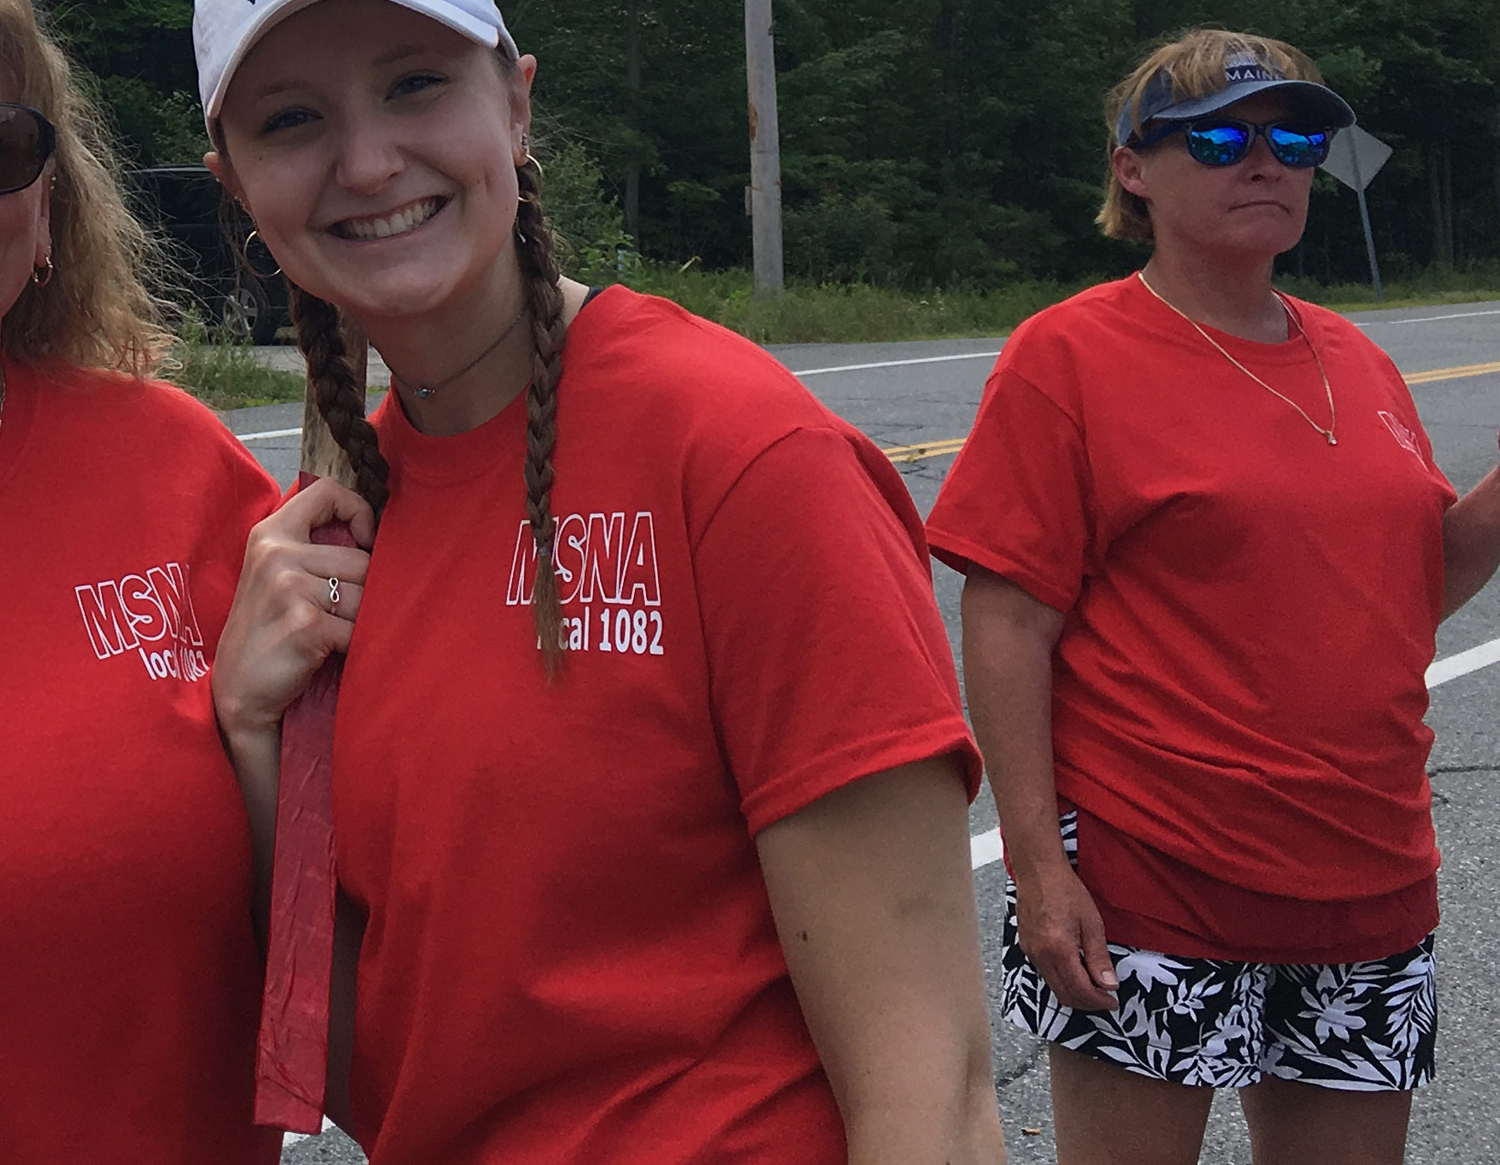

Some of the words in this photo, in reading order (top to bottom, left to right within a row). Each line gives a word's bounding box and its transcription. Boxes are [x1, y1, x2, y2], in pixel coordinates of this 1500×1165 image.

[506, 511, 662, 607] MSNA
[599, 608, 665, 655] 1082
[138, 641, 182, 681] locl
